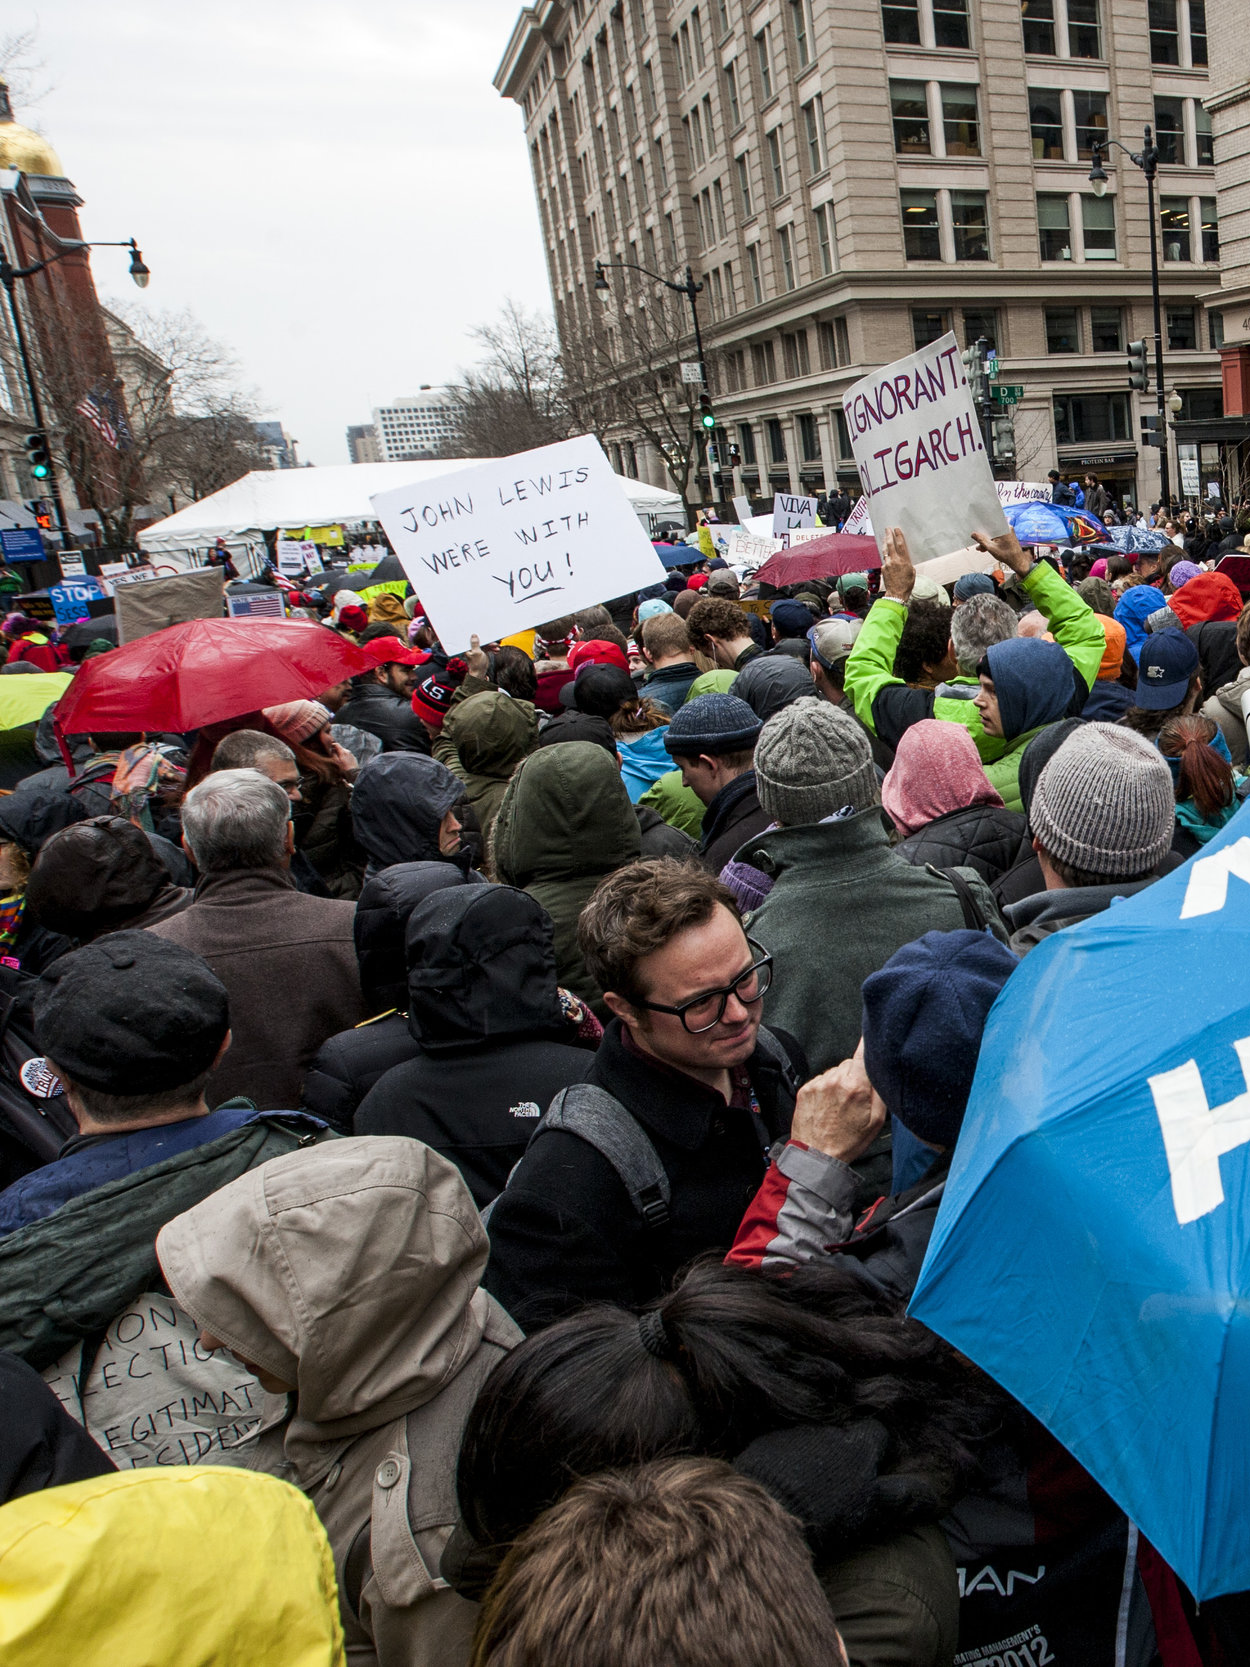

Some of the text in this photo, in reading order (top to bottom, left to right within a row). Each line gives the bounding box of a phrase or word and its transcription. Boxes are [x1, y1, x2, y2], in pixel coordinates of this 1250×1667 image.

[844, 345, 967, 442] IGNORANT.
[1000, 387, 1008, 396] D
[860, 412, 983, 499] OLIGARCH.
[400, 467, 590, 533] JOHN LEWIS
[1014, 482, 1030, 499] this
[780, 496, 811, 516] VIVA
[788, 517, 801, 528] LA
[421, 512, 589, 575] WE'RE WITH
[51, 585, 99, 603] STOP
[57, 605, 89, 621] SESS
[981, 1624, 1041, 1656] MANAGEMENT'S
